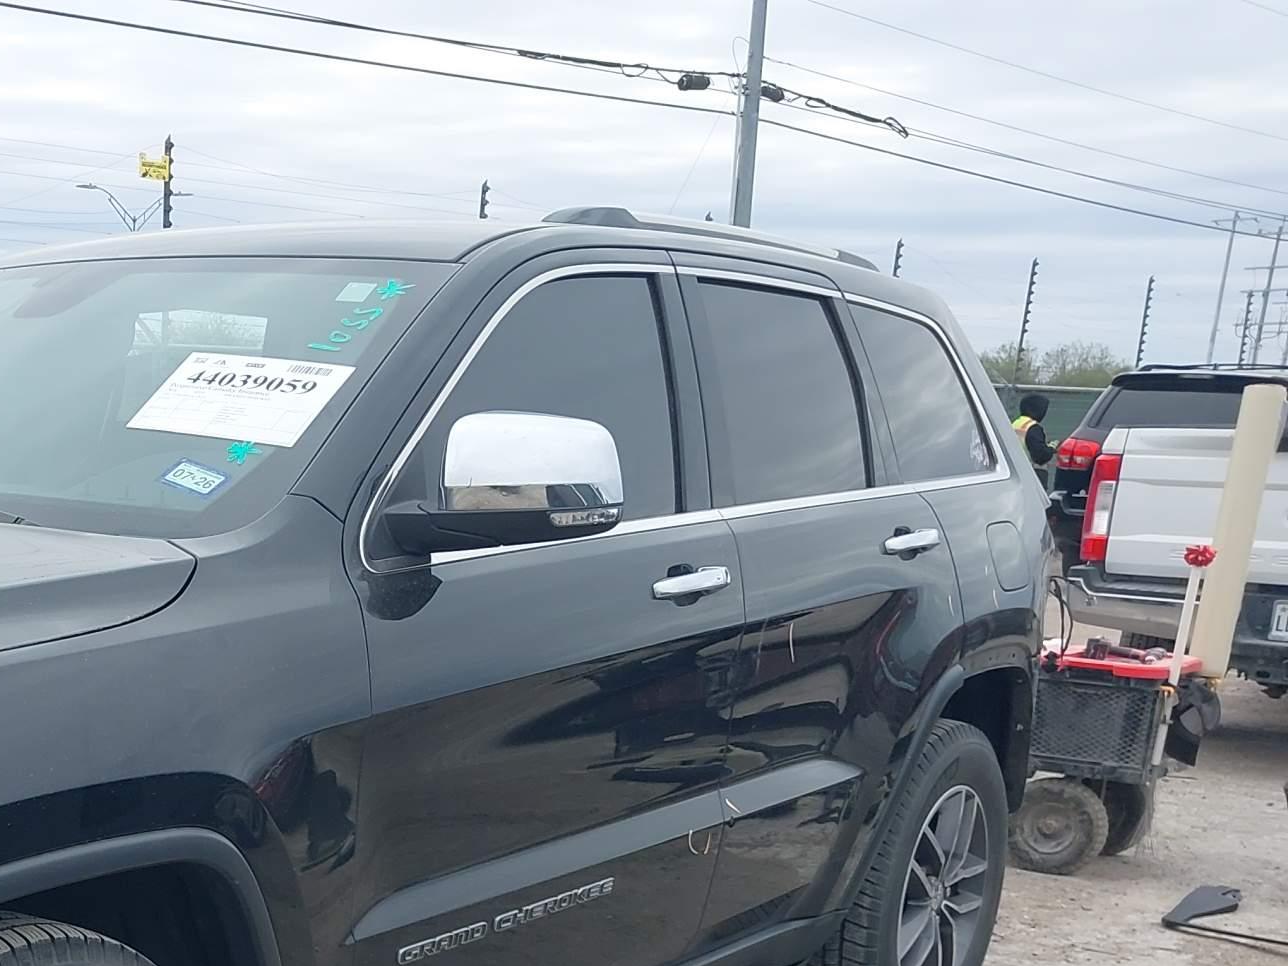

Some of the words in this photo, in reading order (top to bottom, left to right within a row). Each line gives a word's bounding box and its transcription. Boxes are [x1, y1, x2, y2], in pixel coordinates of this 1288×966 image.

[187, 370, 318, 395] 44039059
[397, 921, 488, 965] GRAND
[494, 876, 615, 932] CHEROKEE
